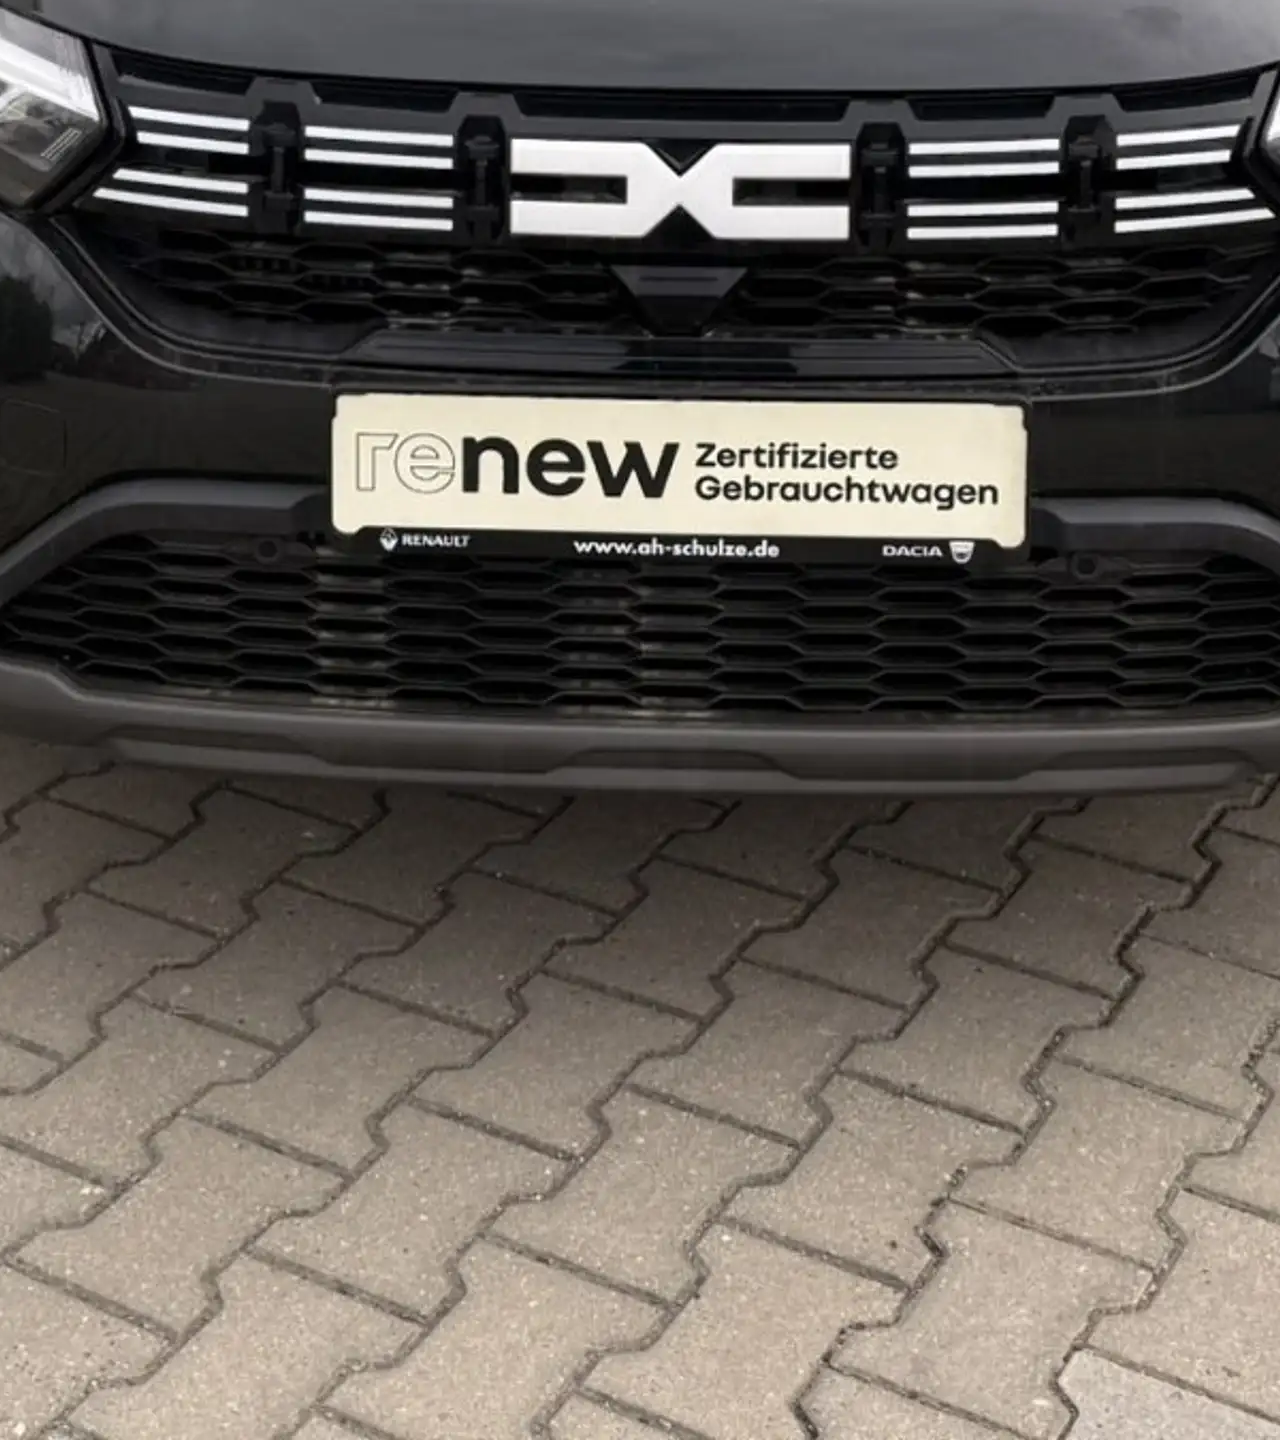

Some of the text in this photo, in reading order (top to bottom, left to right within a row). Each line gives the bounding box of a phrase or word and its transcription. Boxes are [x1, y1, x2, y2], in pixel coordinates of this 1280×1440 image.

[355, 433, 680, 498] renew
[695, 441, 899, 471] Zertifizierte
[694, 474, 999, 511] Gebrauchtwagen
[401, 533, 470, 548] RENAULT
[573, 537, 780, 557] www.ah-schulze.de
[882, 544, 943, 557] DACIA
